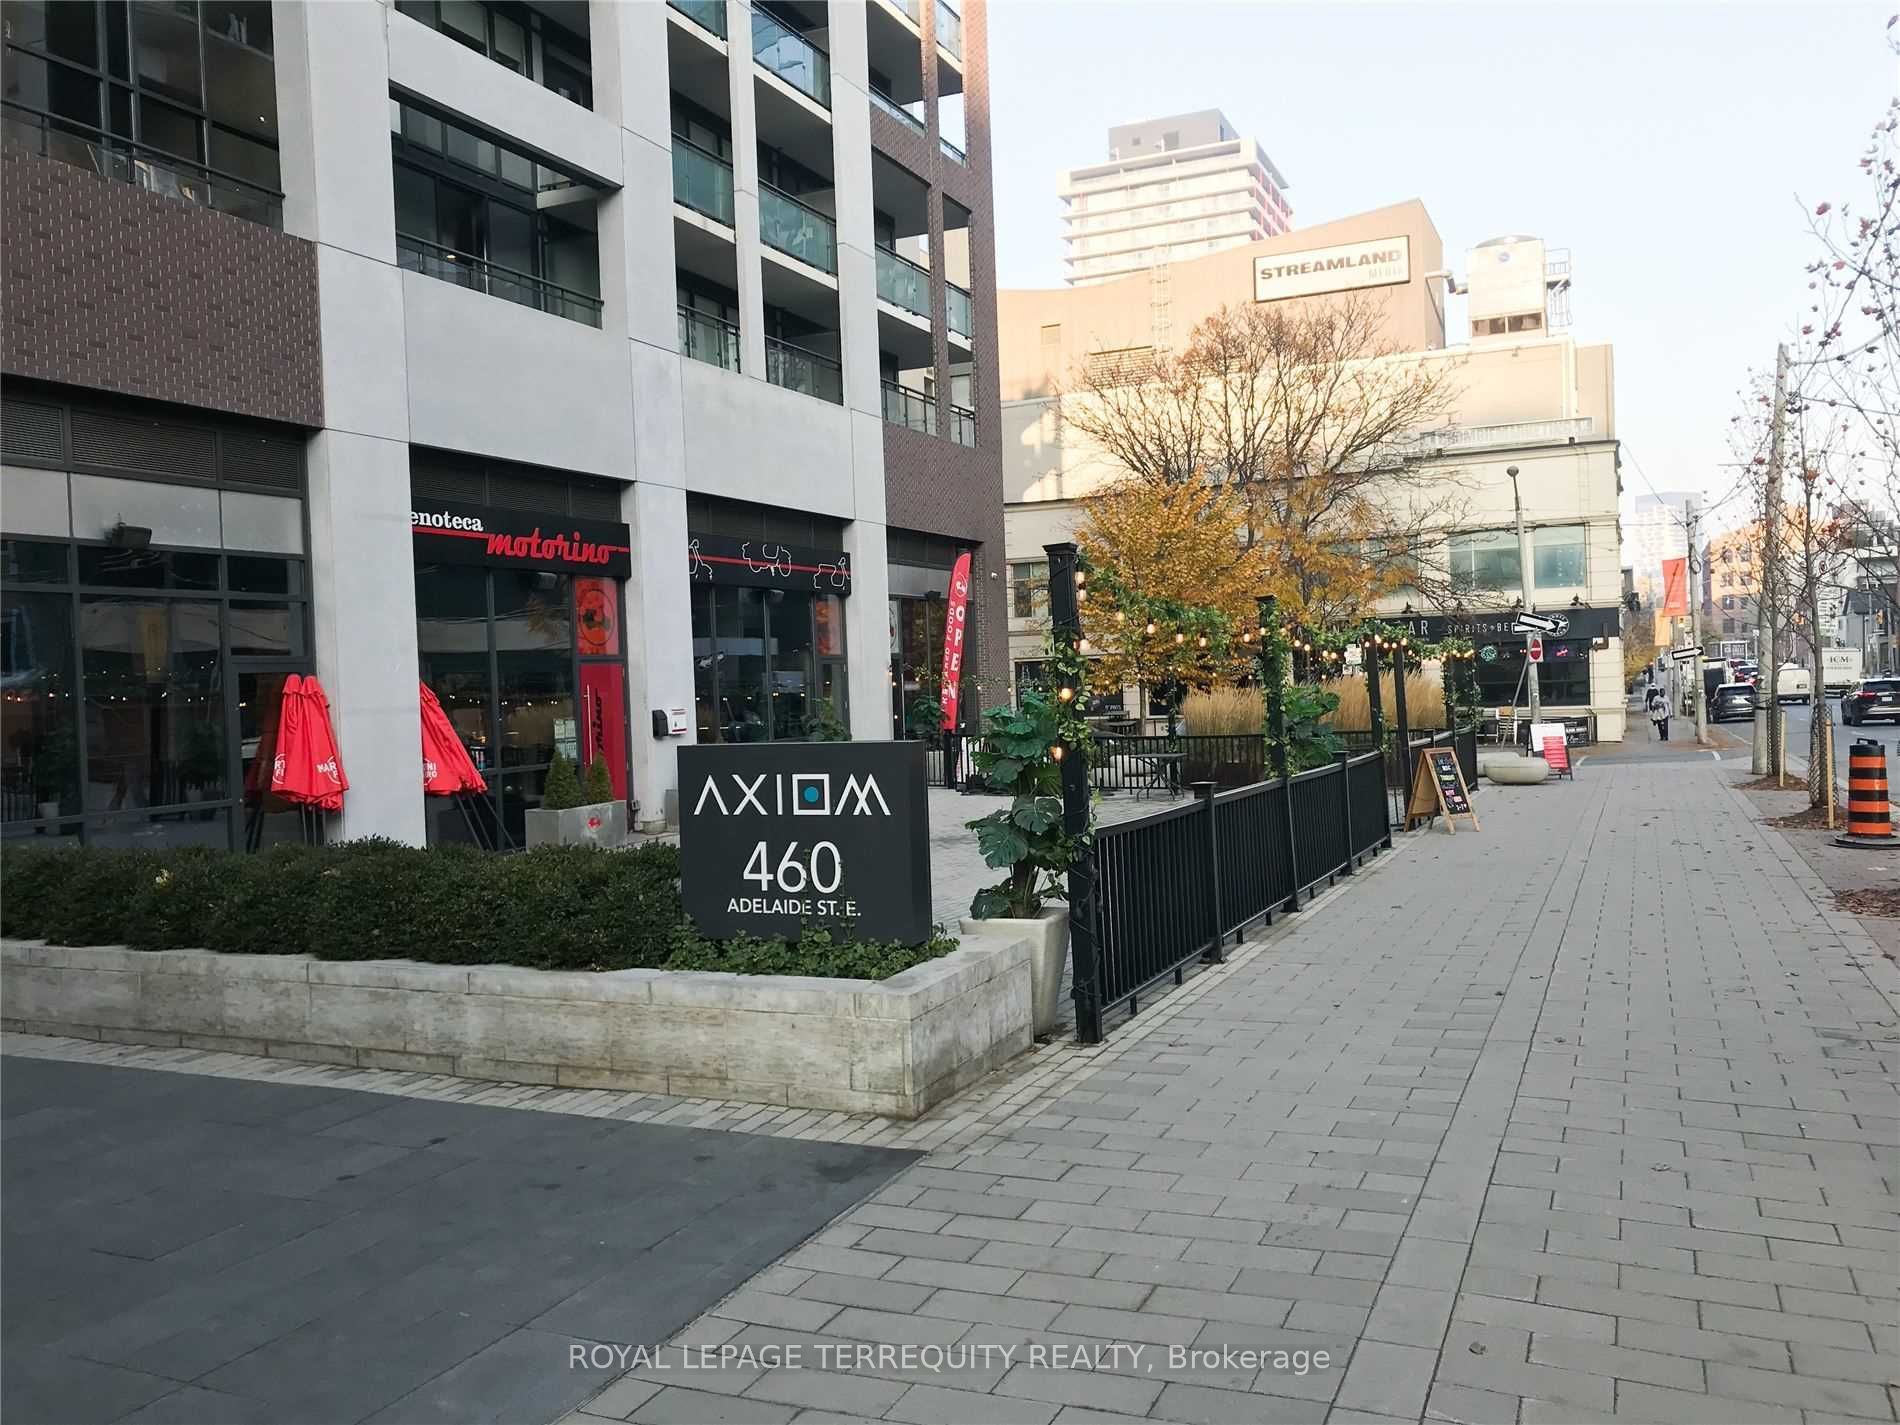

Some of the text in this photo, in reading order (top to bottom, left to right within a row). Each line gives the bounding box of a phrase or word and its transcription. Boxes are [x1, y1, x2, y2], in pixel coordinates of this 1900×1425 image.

[1260, 249, 1401, 280] STREAMLAND
[410, 510, 484, 532] enoteca
[486, 527, 611, 564] motorino
[1408, 620, 1428, 635] AR
[948, 605, 965, 699] OPEN
[693, 773, 891, 816] AXIOM
[743, 840, 842, 894] 460
[727, 897, 862, 917] ADELAIDE ST. E.
